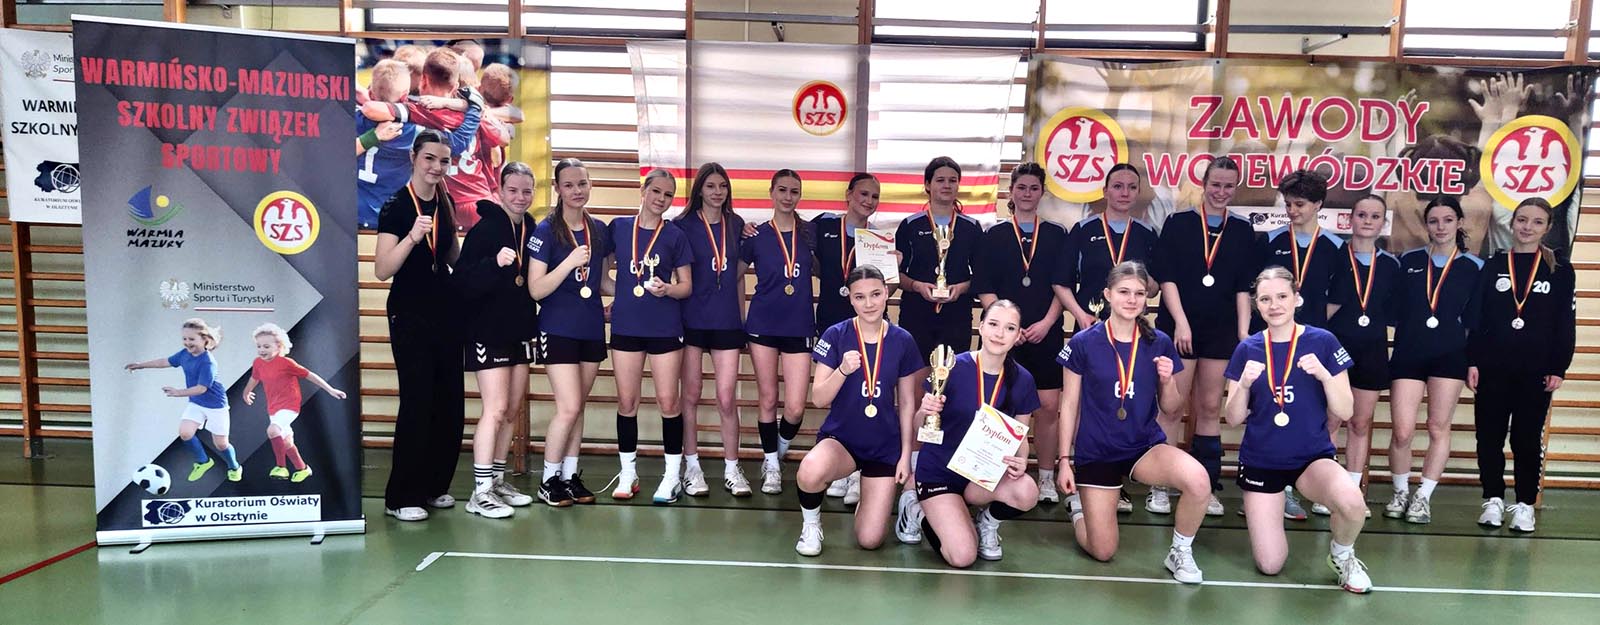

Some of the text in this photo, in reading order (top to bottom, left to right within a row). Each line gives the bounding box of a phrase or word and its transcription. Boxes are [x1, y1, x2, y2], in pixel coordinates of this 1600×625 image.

[80, 57, 350, 101] WARMIŃSKO-MAZURSKI
[117, 101, 321, 144] SZKOLNY ZWIĄZEK
[804, 112, 836, 126] SZS
[1188, 96, 1429, 144] ZAWODY
[160, 142, 282, 175] SPORTOWY
[1054, 153, 1105, 183] SZS
[1503, 164, 1556, 194] SZS
[127, 229, 184, 239] WARMIA
[269, 223, 304, 242] SZS
[127, 239, 184, 249] MAZURY
[193, 282, 255, 292] Ministerstwo
[1532, 280, 1551, 294] 20
[193, 293, 225, 304] Sportu
[232, 294, 275, 305] Turystyki
[981, 424, 1012, 445] Dyplom
[195, 495, 320, 509] Kuratorium Oświaty
[210, 511, 269, 523] Olsztynie
